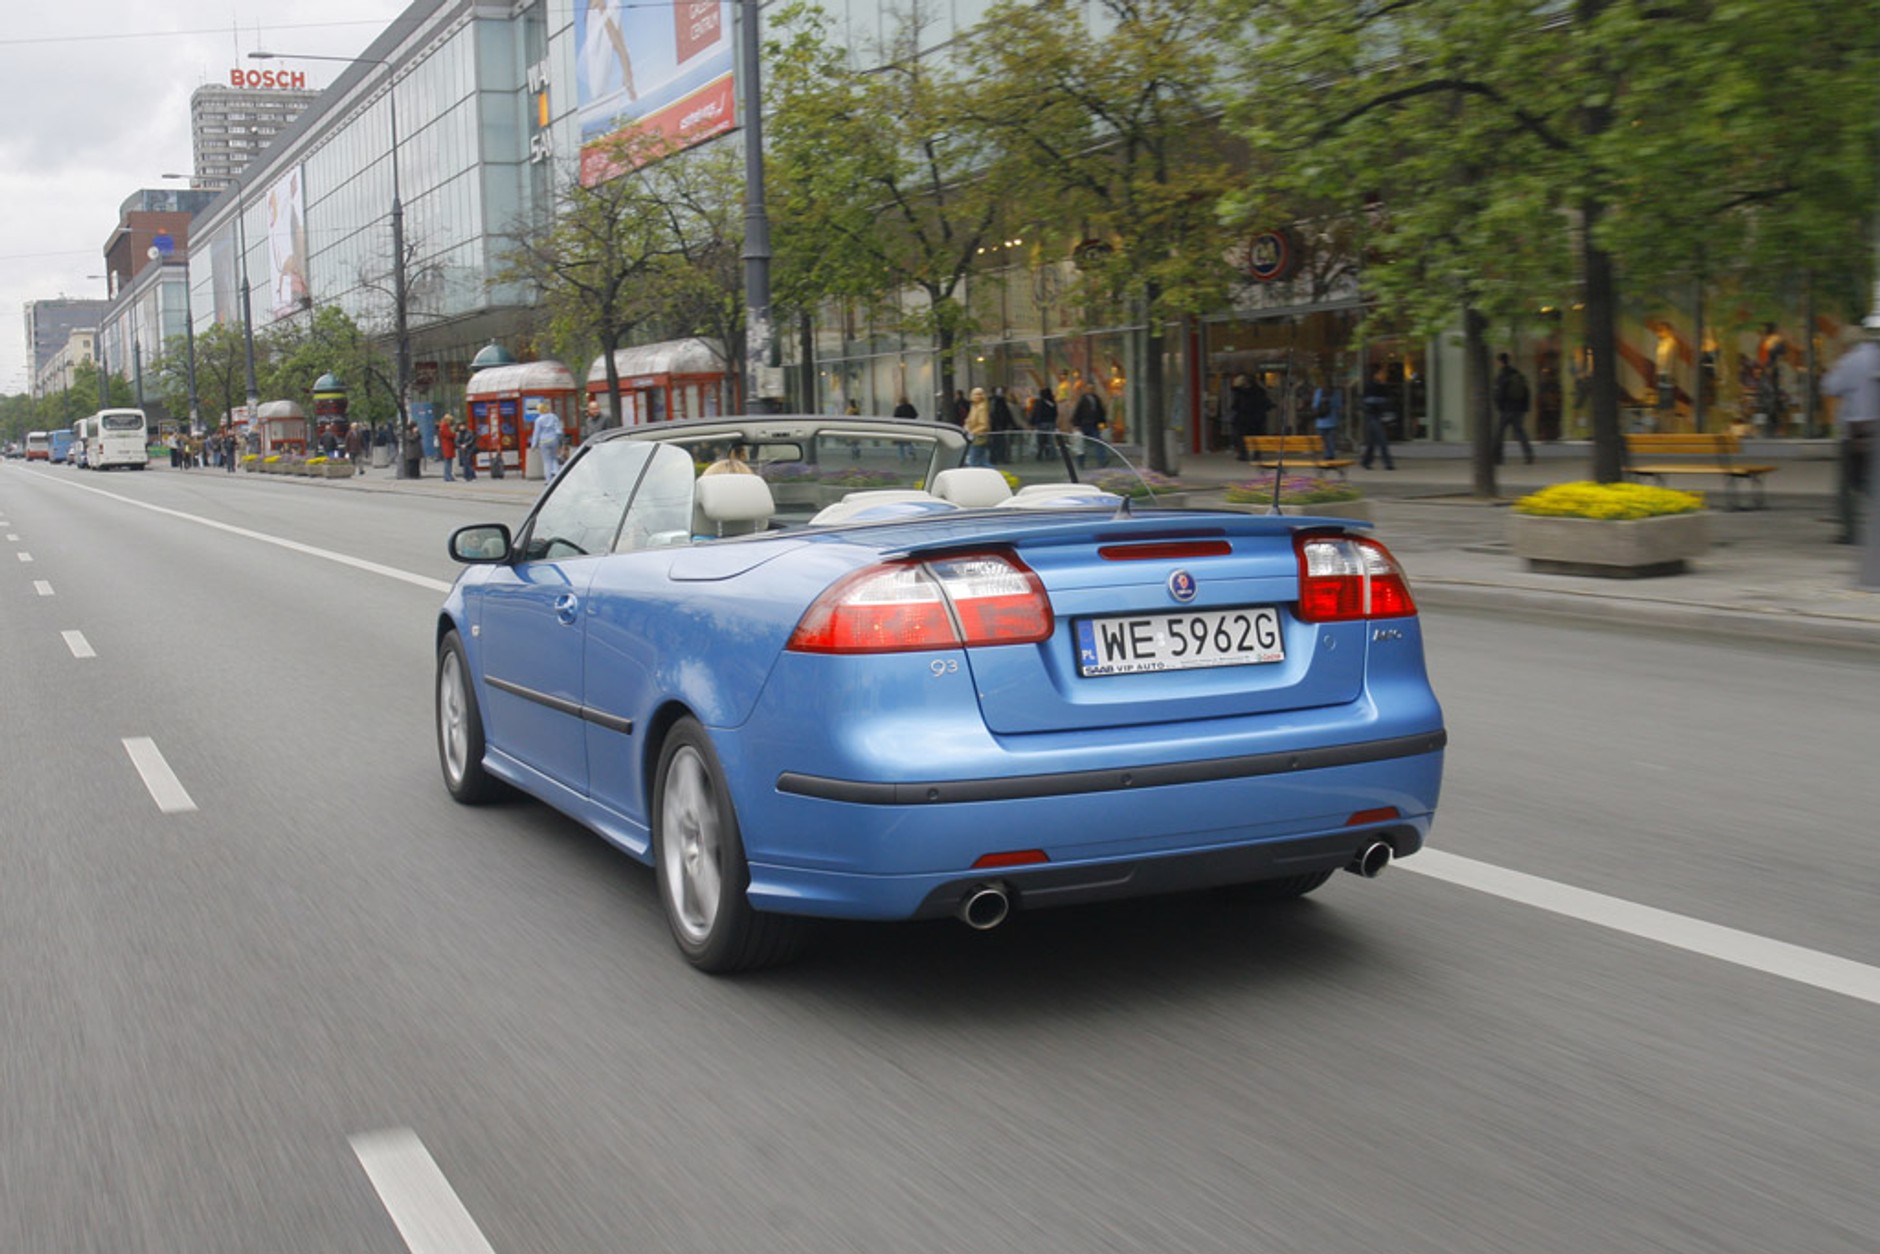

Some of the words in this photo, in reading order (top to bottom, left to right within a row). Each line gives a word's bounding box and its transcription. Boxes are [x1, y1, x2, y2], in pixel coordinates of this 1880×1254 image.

[230, 69, 305, 88] BOSCH
[1102, 621, 1156, 661] WE
[1167, 613, 1276, 656] 5962G
[1082, 649, 1095, 660] PL
[1116, 664, 1134, 672] VIP
[1136, 662, 1165, 671] AUTO
